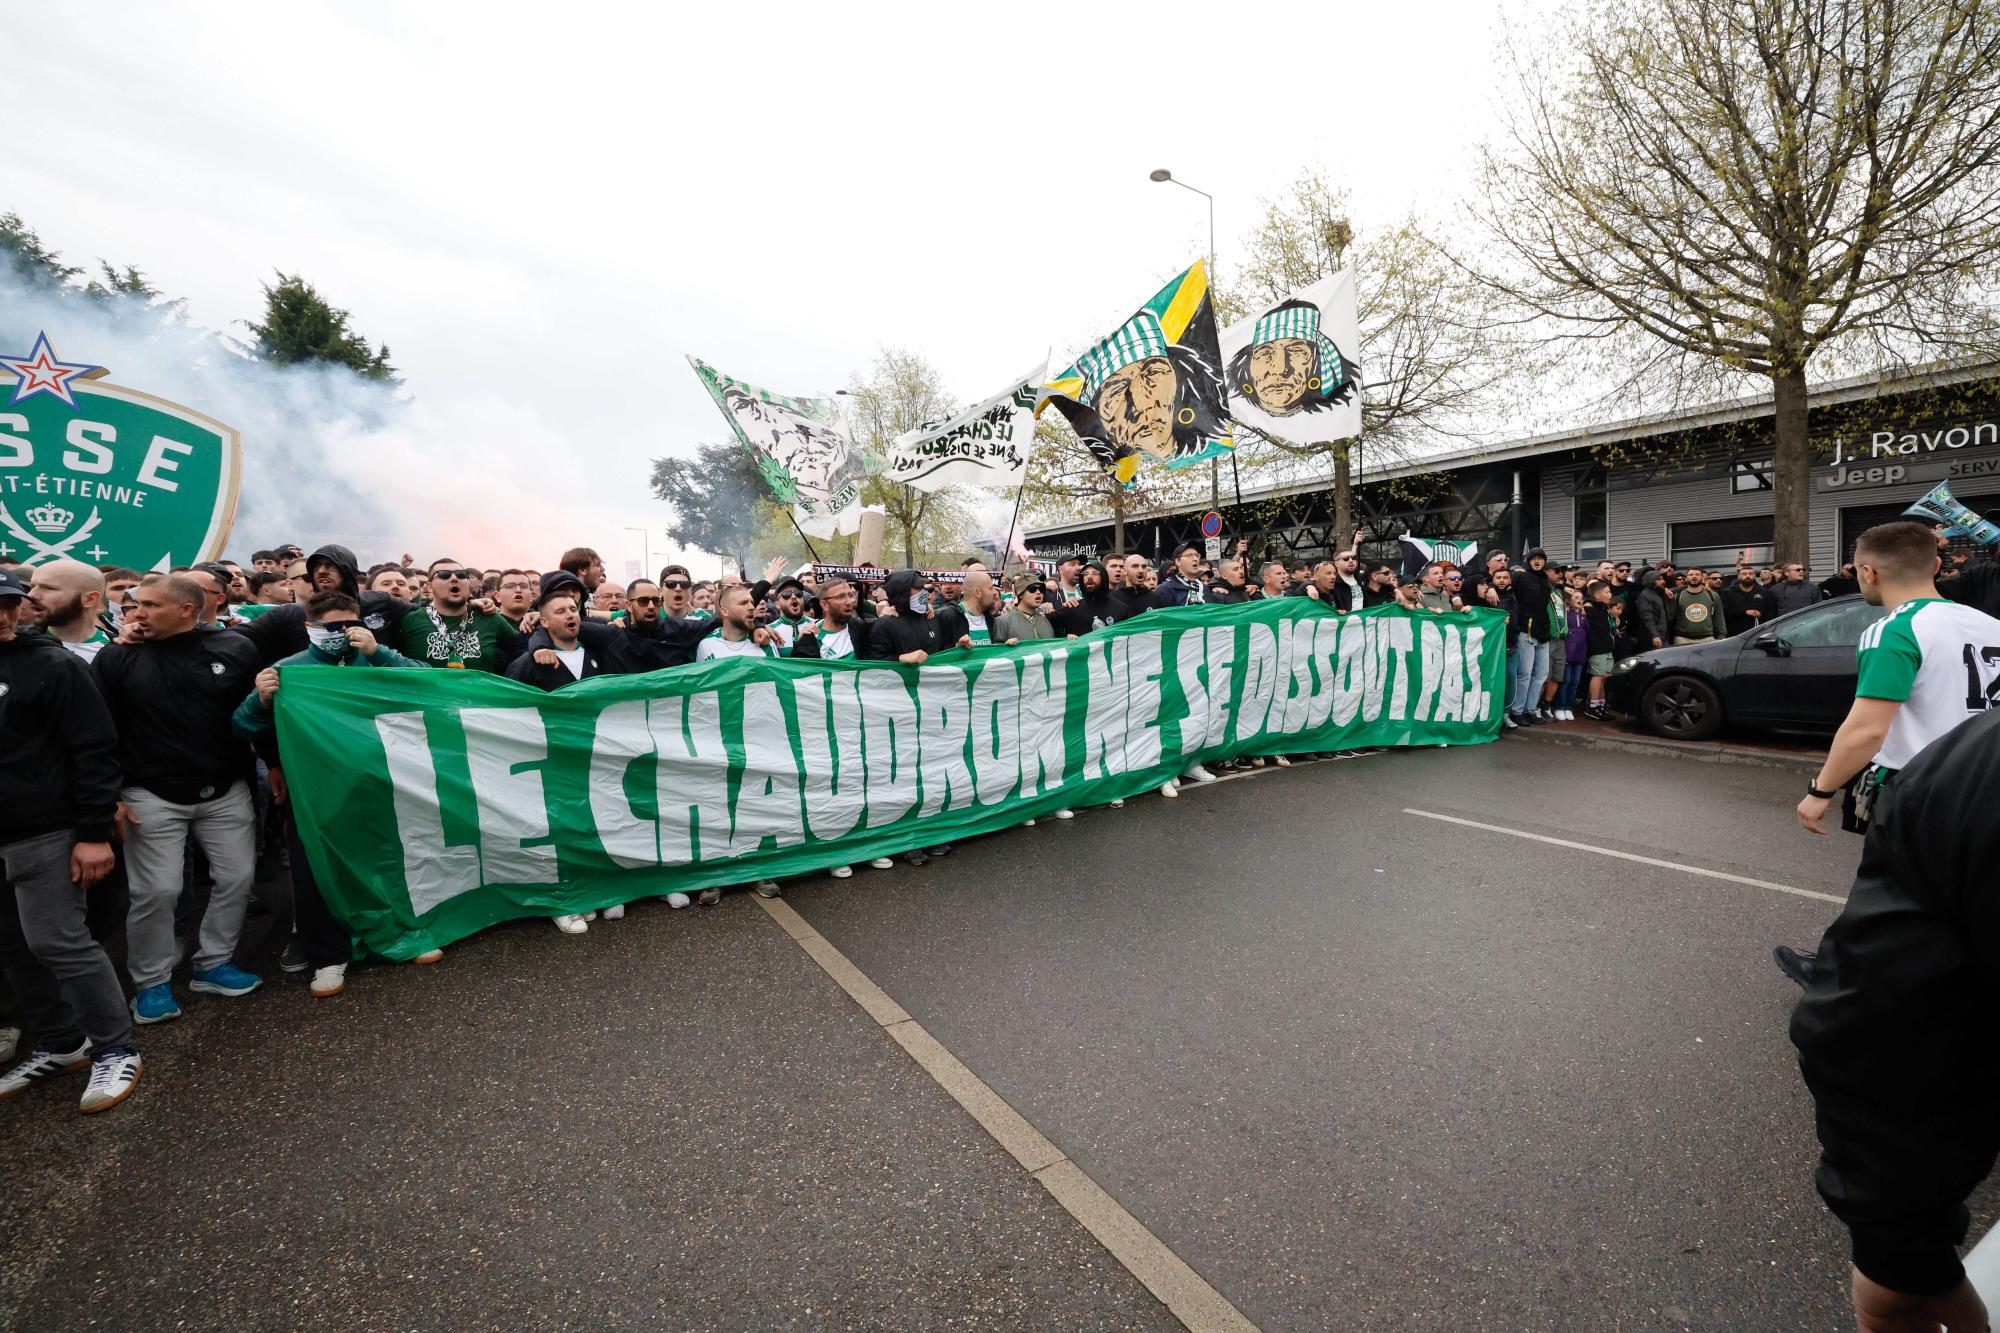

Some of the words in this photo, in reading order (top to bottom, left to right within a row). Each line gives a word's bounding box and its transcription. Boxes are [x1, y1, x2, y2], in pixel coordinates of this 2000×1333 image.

[1830, 438, 1854, 466] J.
[1872, 423, 1998, 458] Ravon
[0, 473, 148, 508] T-ÉTIENNE
[1826, 465, 1907, 487] Jeep
[374, 706, 560, 918] LE
[589, 647, 1068, 870] CHAUDRON
[1083, 630, 1163, 781] NE
[1176, 625, 1235, 755] SE
[1236, 615, 1413, 741] DISSOUT
